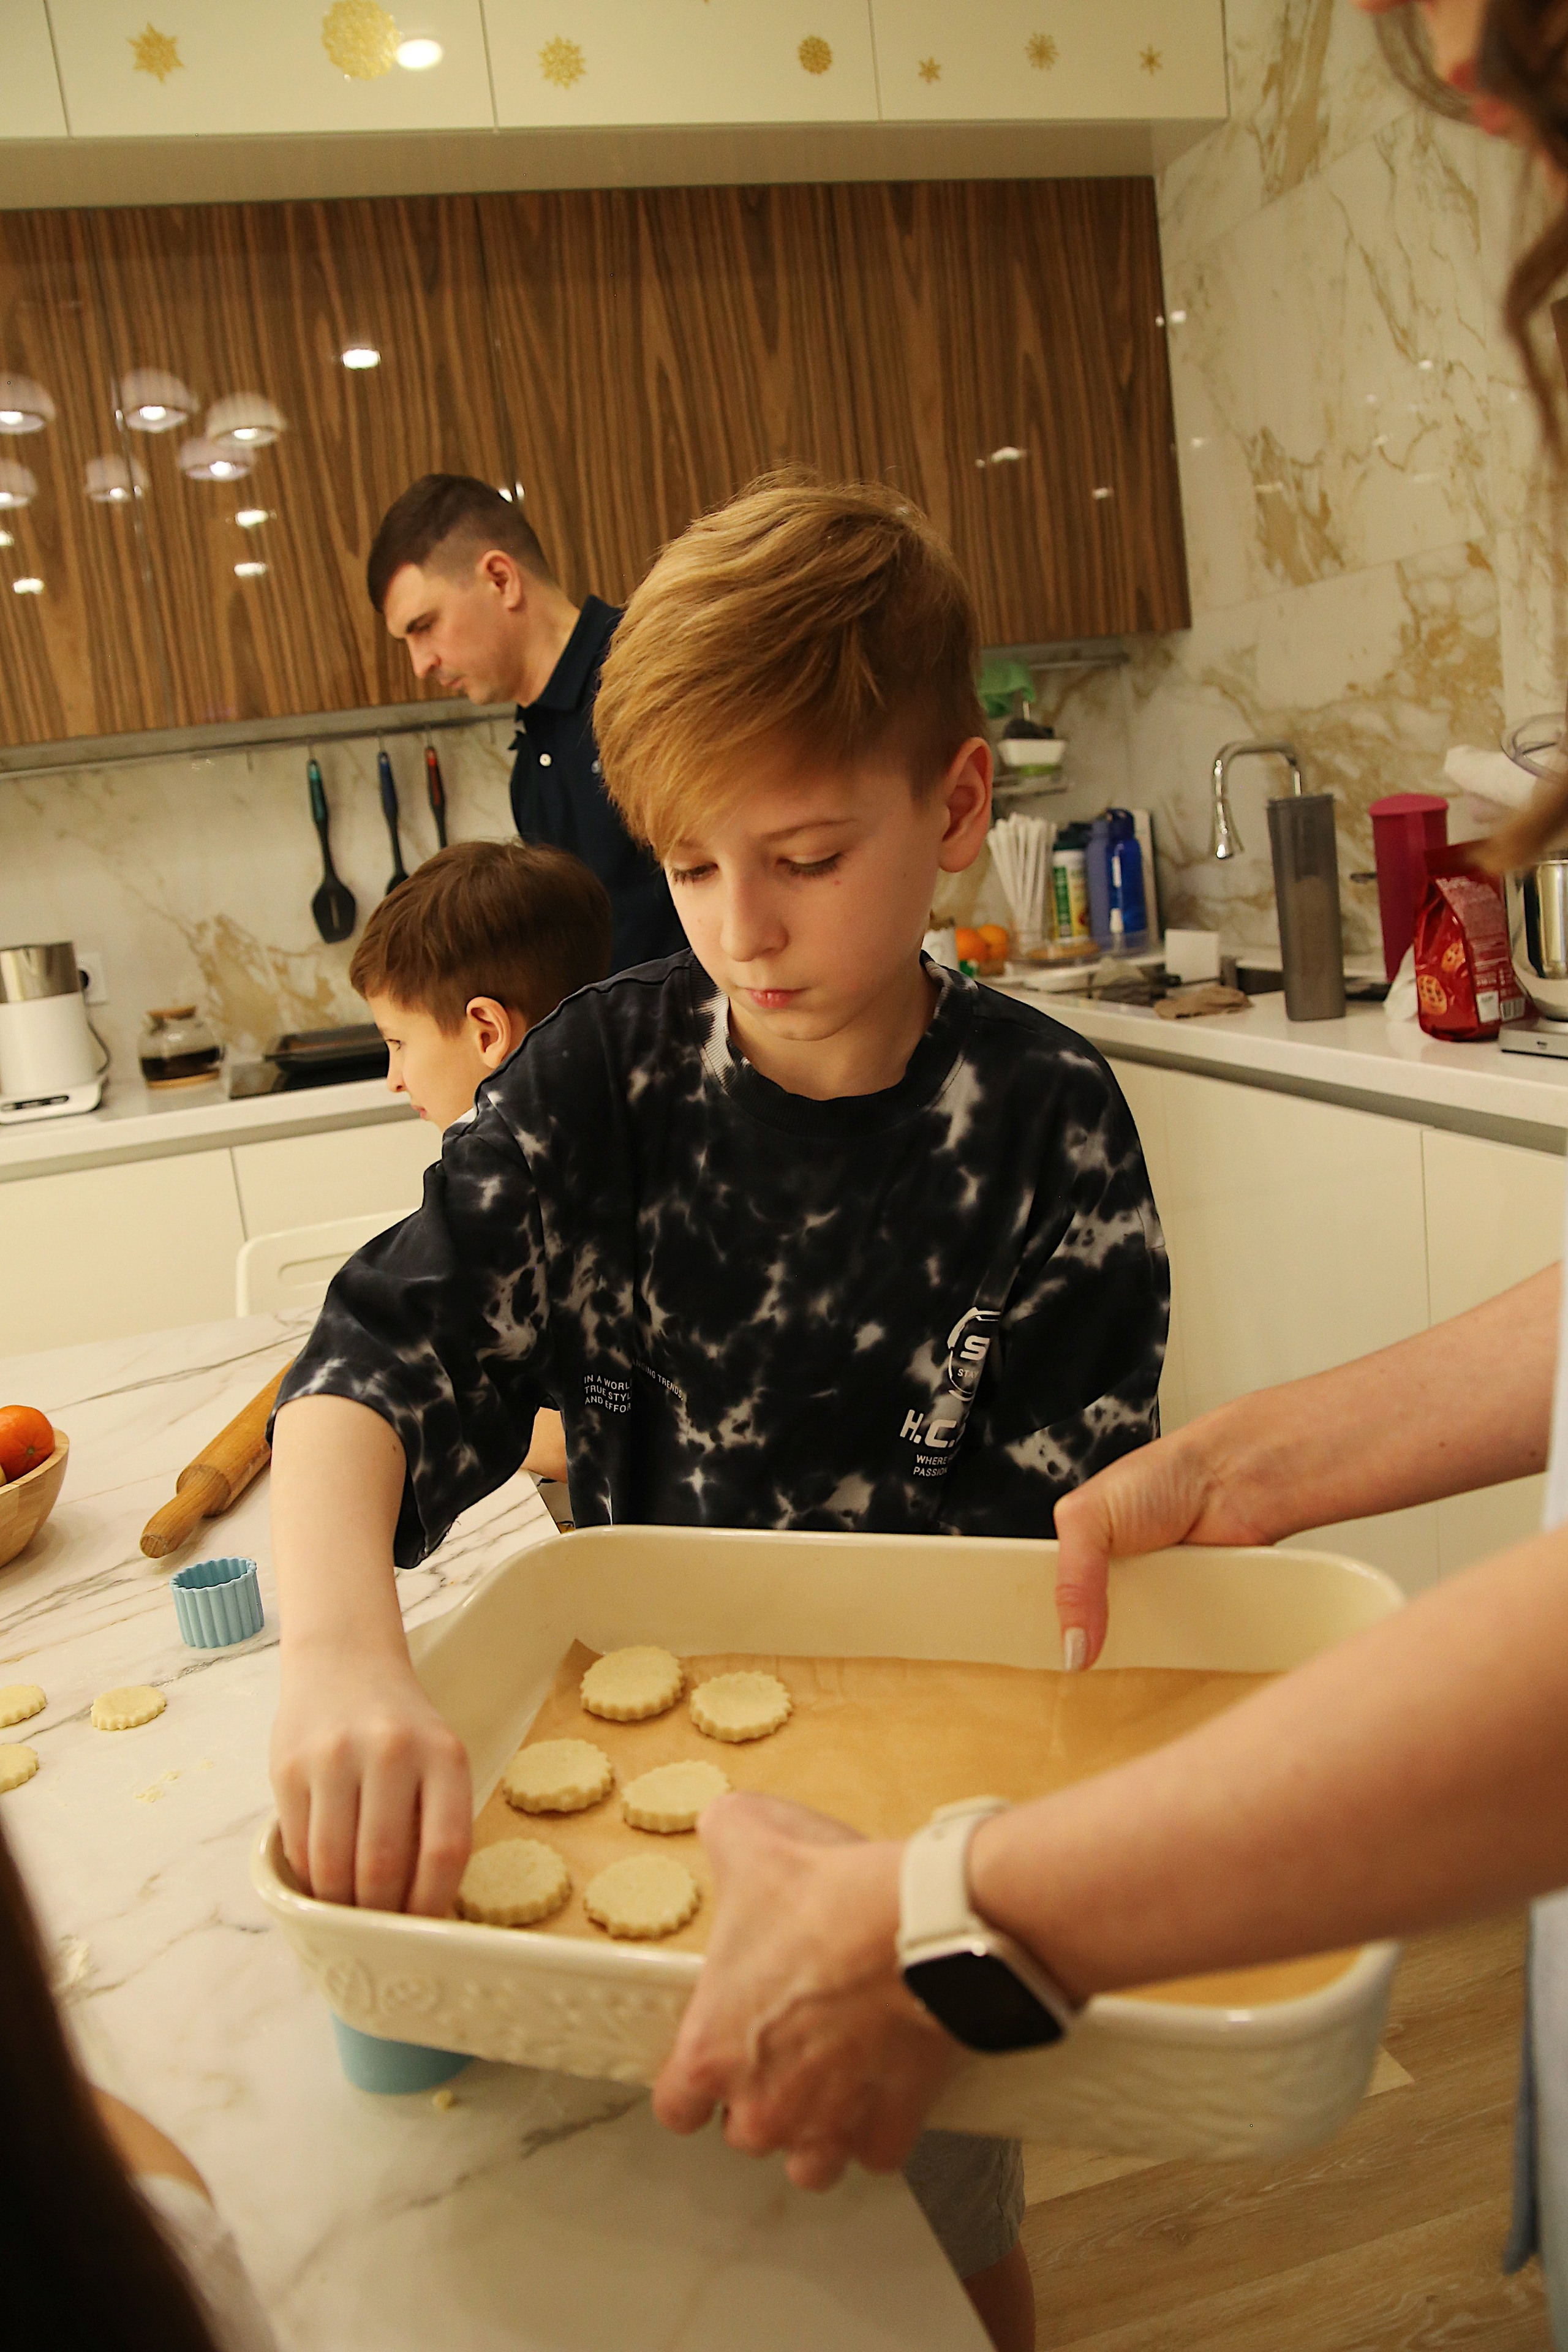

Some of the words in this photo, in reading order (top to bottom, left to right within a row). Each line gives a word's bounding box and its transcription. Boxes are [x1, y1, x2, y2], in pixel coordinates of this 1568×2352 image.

[960, 1335, 990, 1360] S
[584, 1374, 593, 1384] IN
[597, 1375, 602, 1384] A
[604, 1378, 631, 1390] WORL
[584, 1385, 606, 1396] TRUE
[608, 1391, 631, 1401] STYL
[585, 1395, 603, 1405] AND
[605, 1400, 631, 1412] EFFOR
[916, 1454, 948, 1465] WHERE
